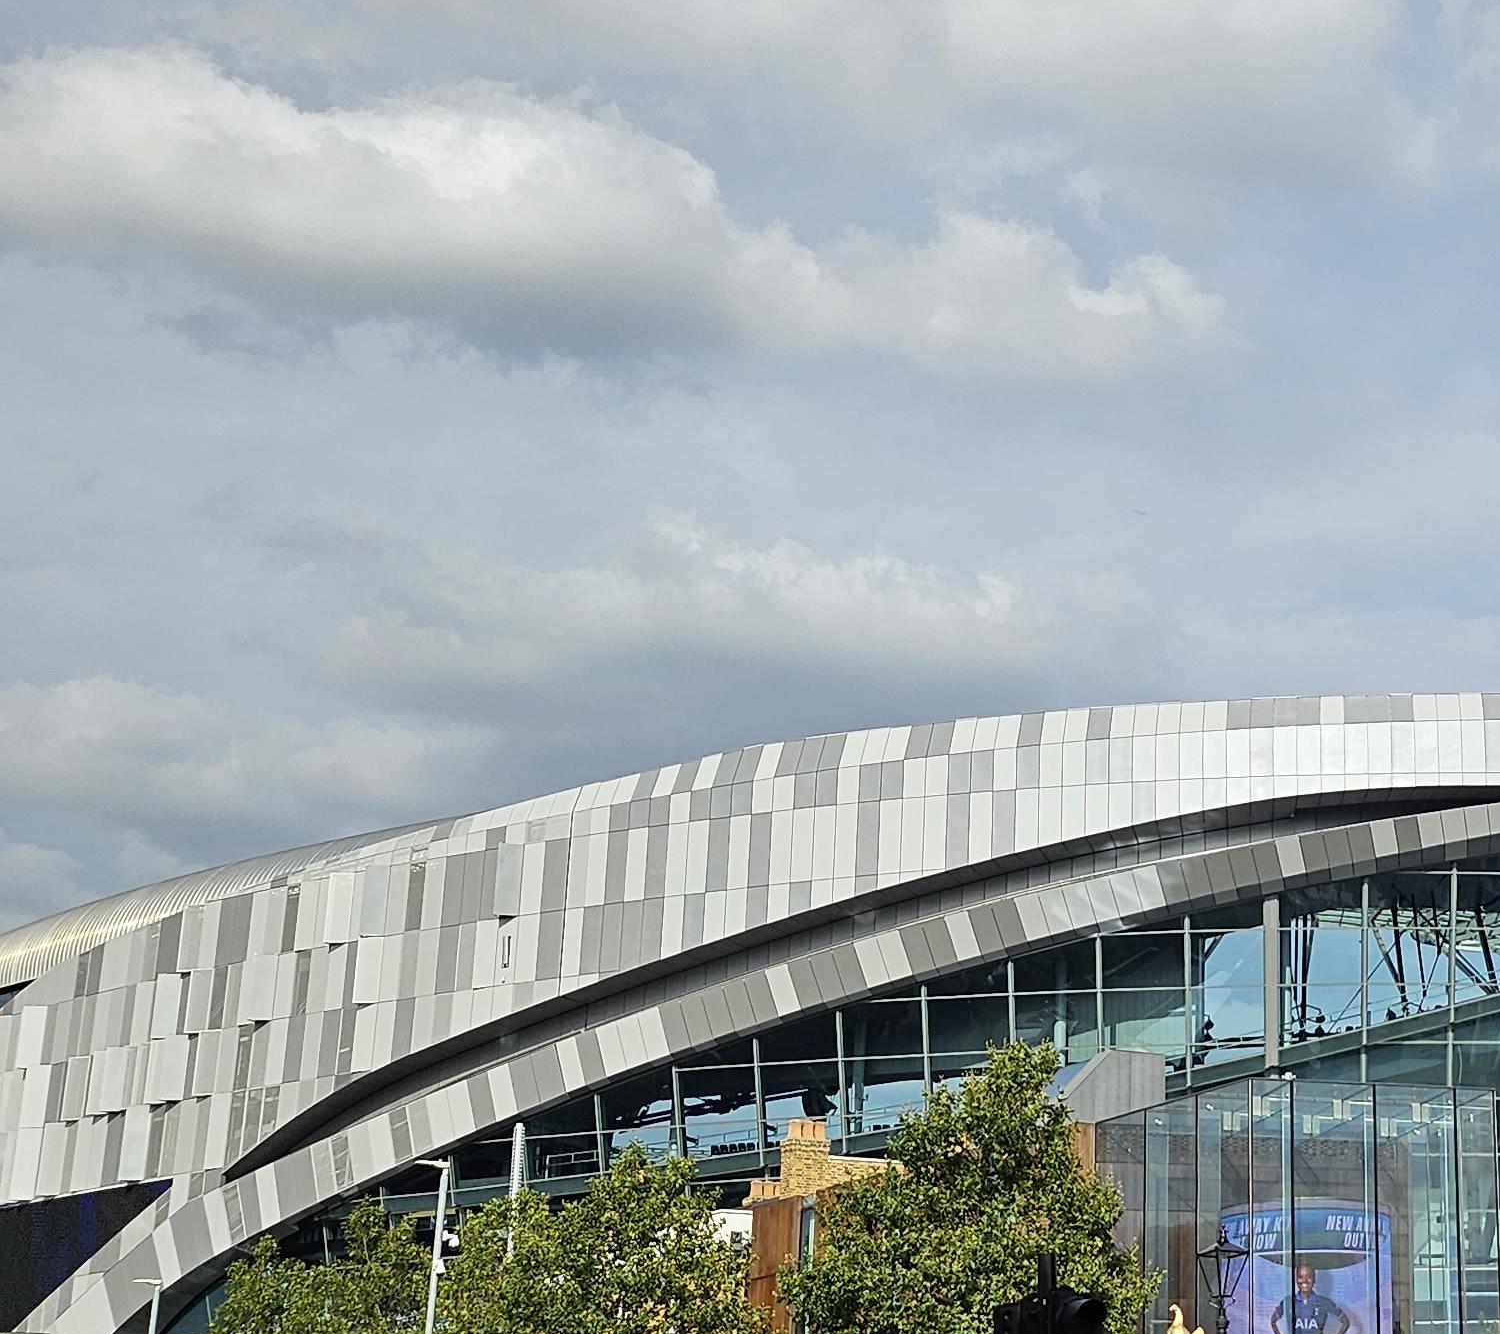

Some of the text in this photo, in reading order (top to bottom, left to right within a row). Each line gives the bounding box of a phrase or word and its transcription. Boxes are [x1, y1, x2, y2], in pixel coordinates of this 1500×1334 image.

[1326, 1214, 1353, 1231] NEW
[1344, 1231, 1365, 1248] OUT
[1295, 1318, 1318, 1329] AIA
